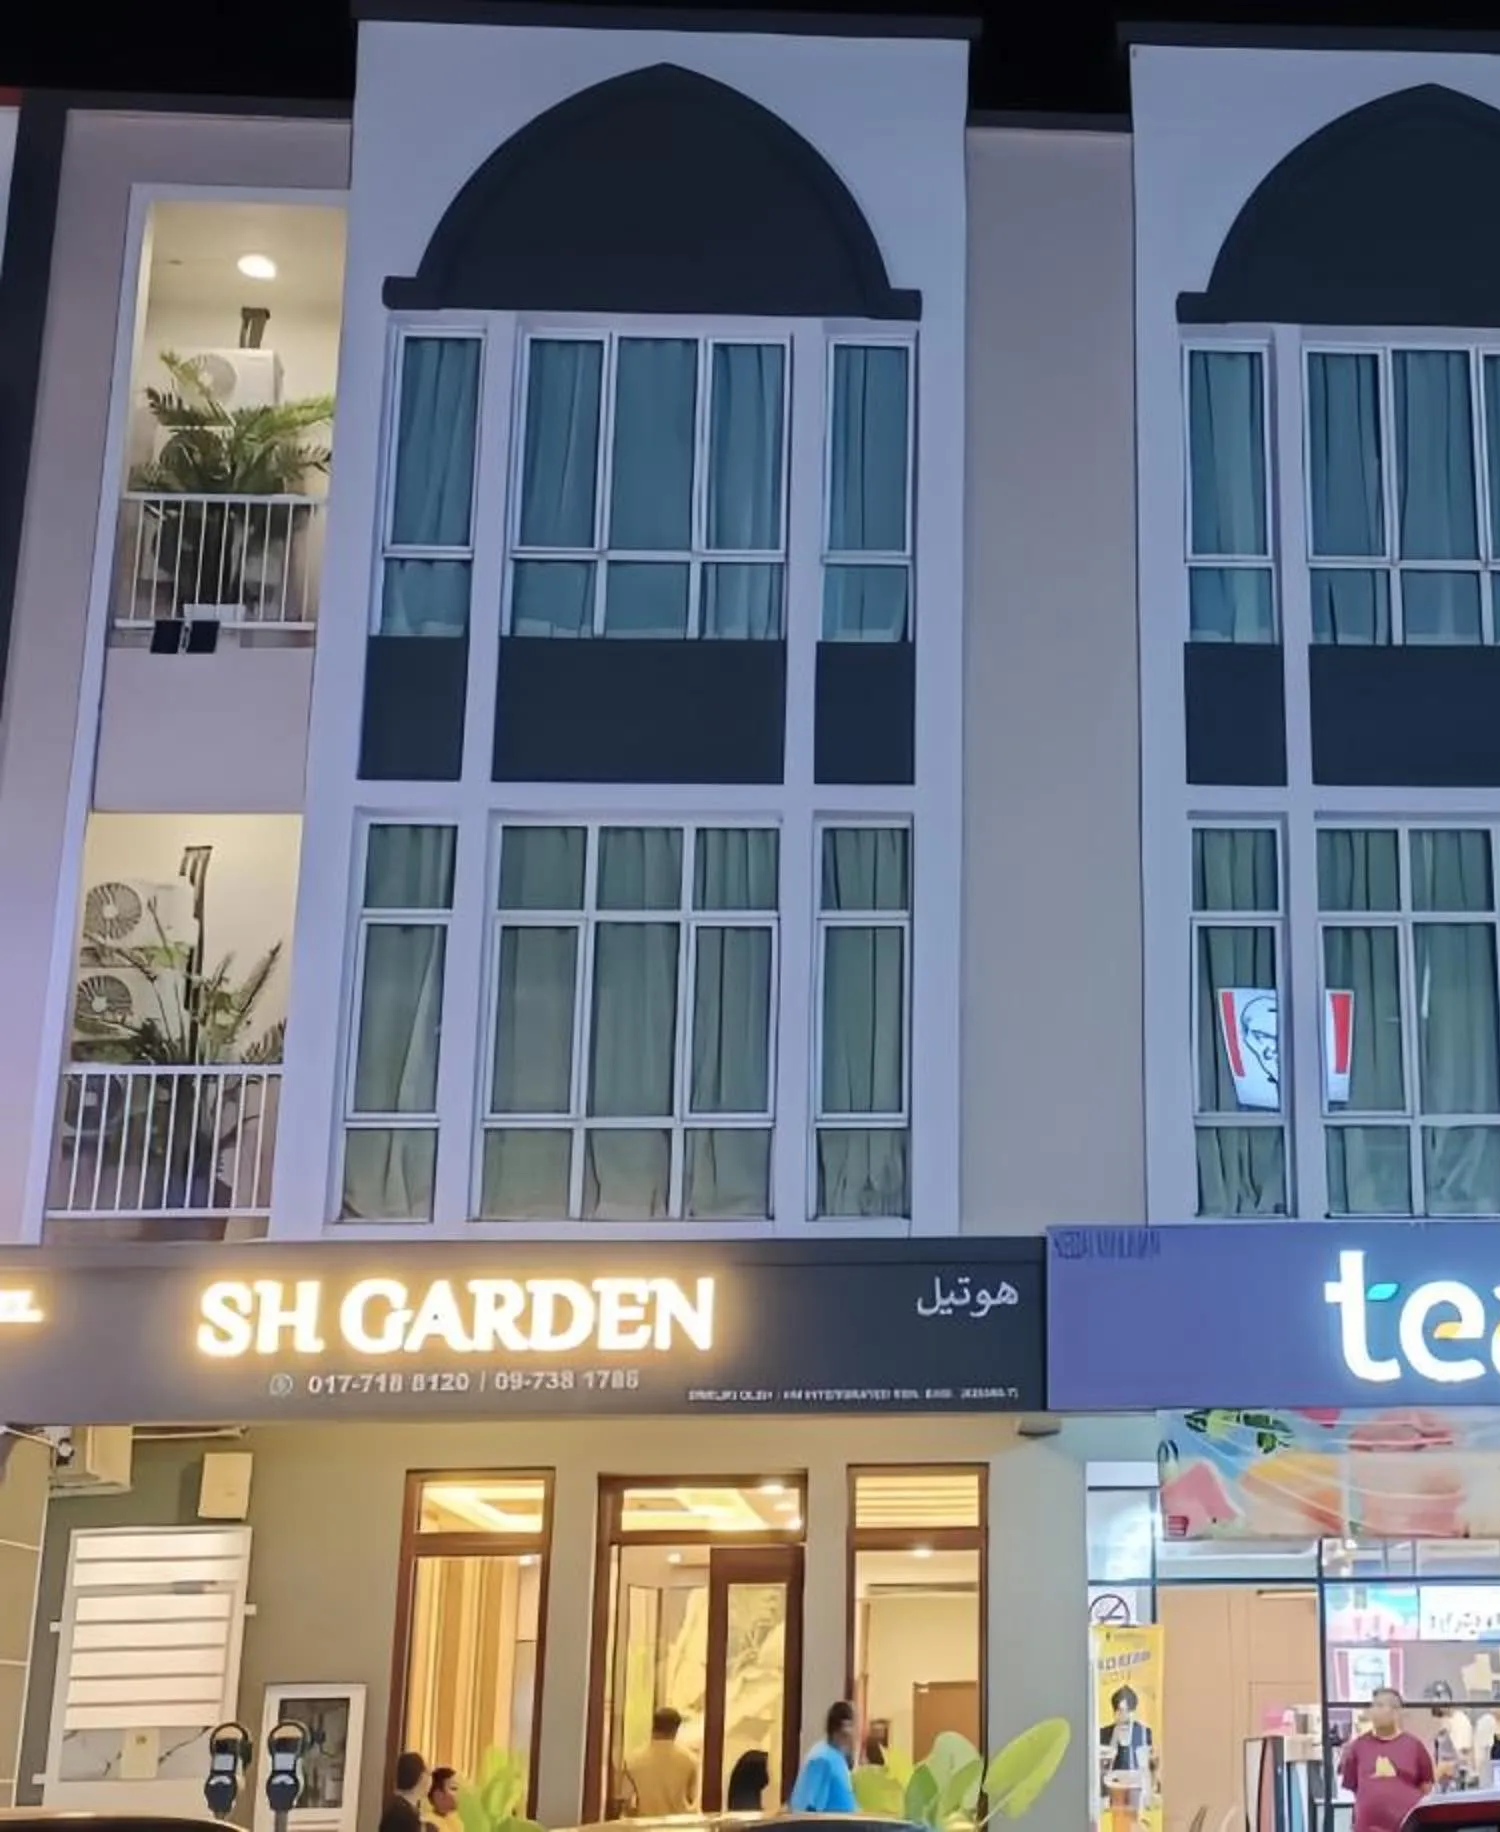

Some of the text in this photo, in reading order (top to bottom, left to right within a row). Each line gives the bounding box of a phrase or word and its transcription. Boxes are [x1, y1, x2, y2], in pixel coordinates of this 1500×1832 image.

[196, 1276, 716, 1357] SH GARDEN
[917, 1275, 1019, 1317] هوتيل
